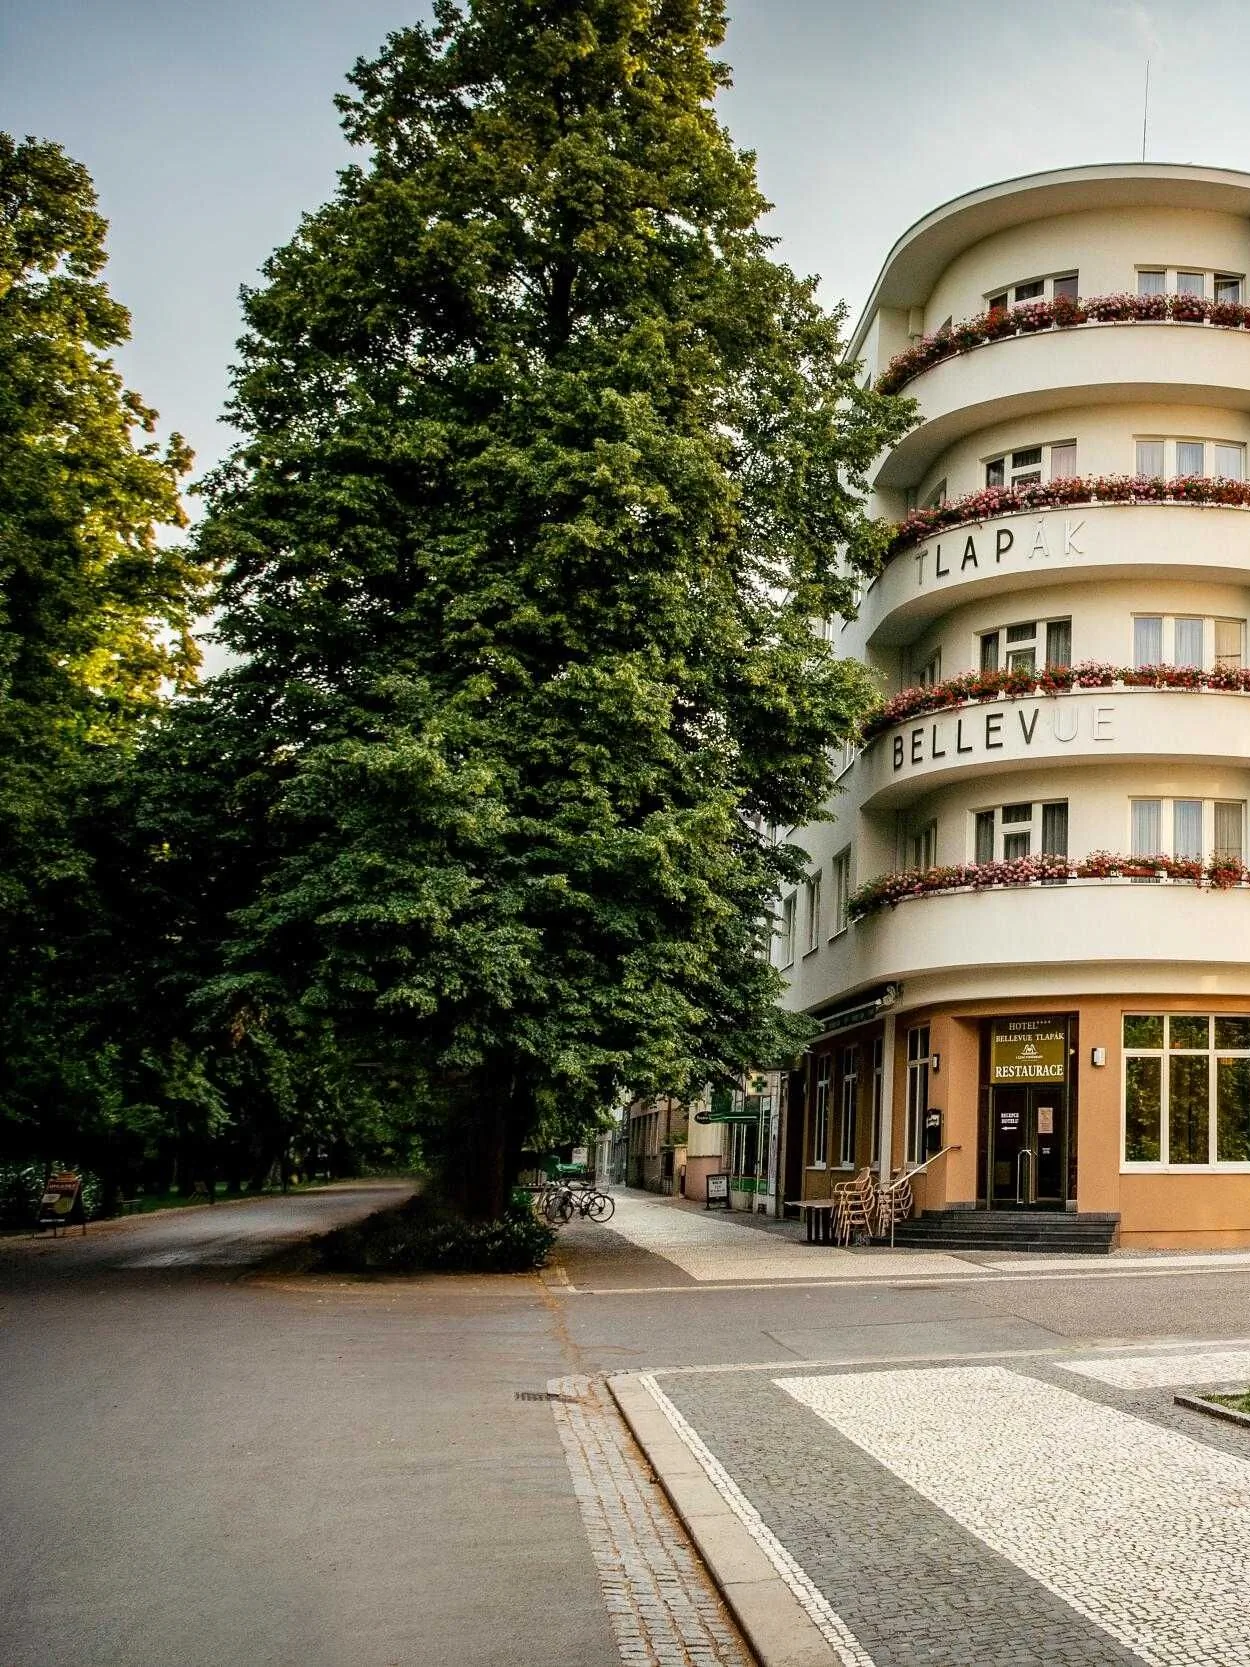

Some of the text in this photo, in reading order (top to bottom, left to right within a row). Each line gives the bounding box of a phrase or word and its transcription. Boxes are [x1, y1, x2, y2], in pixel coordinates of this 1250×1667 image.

[914, 516, 1087, 585] TLAPÁK
[893, 707, 1116, 772] BELLEVUE
[1008, 1021, 1038, 1031] HOTEL
[995, 1031, 1065, 1043] BELLEVUE TLAPÁK
[995, 1064, 1064, 1077] RESTAURACE
